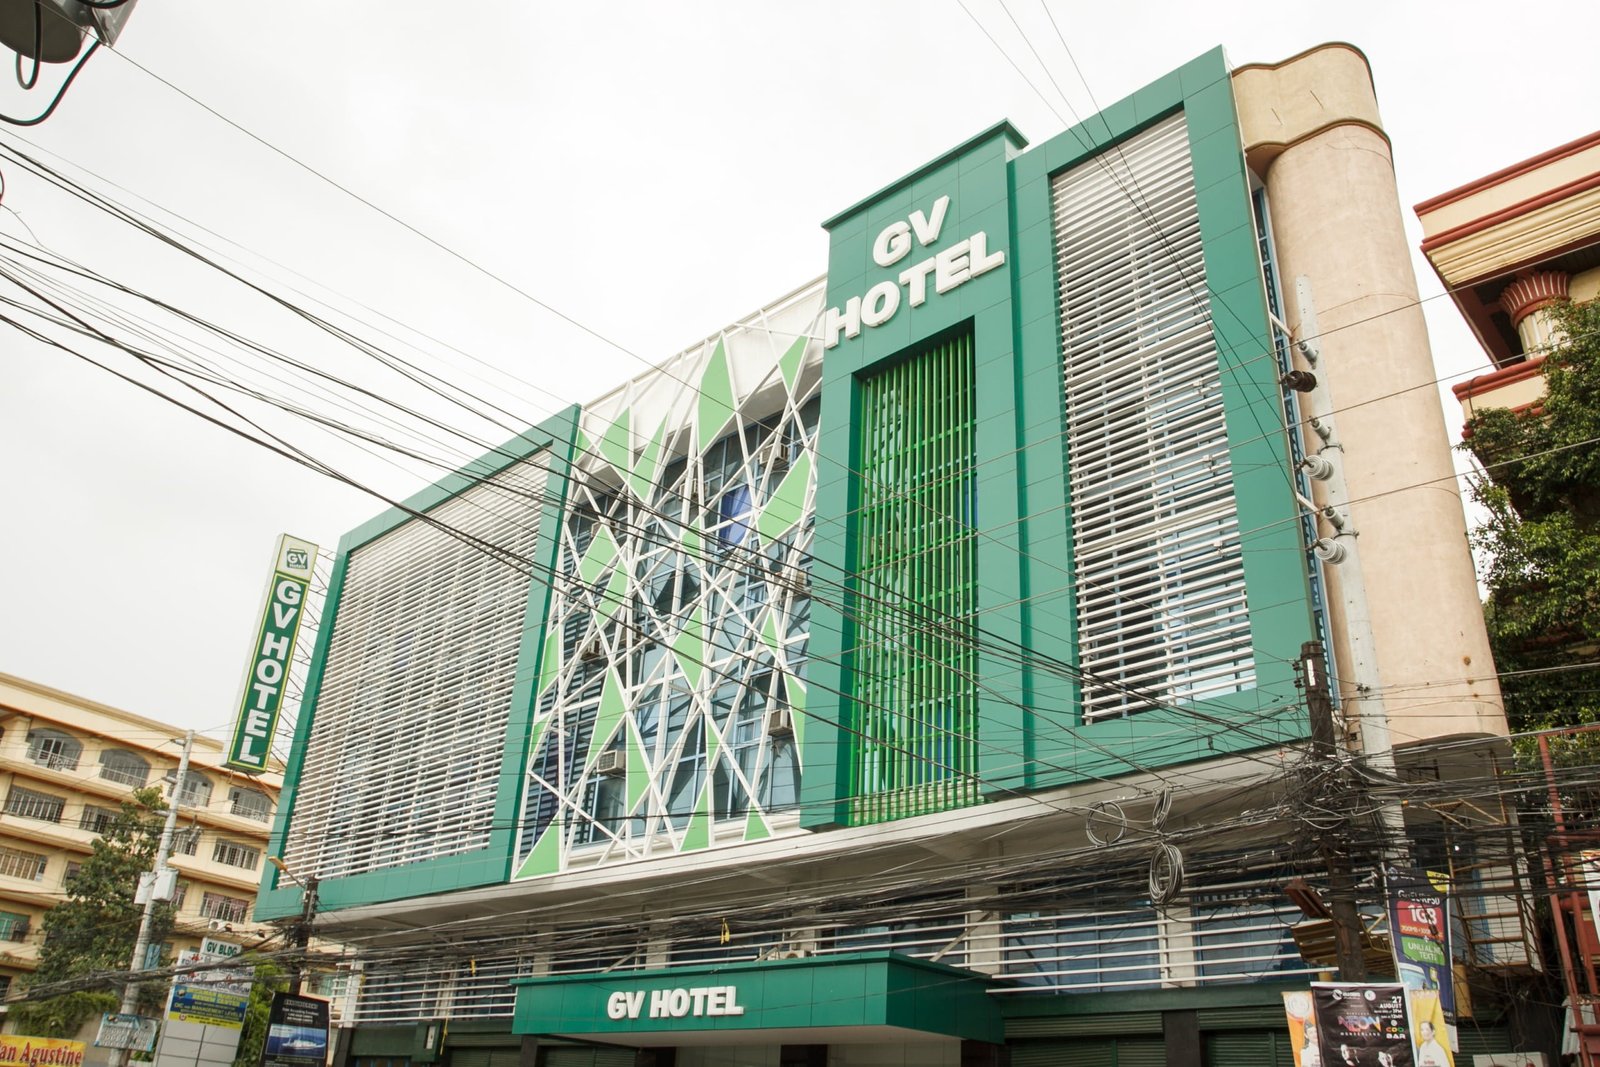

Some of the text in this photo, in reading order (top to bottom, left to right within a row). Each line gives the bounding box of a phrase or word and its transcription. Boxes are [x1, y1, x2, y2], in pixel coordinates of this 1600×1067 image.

[872, 194, 950, 268] GV
[824, 230, 1006, 350] HOTEL
[287, 552, 307, 564] GV
[238, 579, 303, 766] GV HOTEL
[1407, 904, 1438, 925] 1GB
[206, 942, 217, 953] GV
[607, 985, 745, 1020] GV HOTEL
[1391, 995, 1402, 1004] 27
[0, 1041, 17, 1061] an
